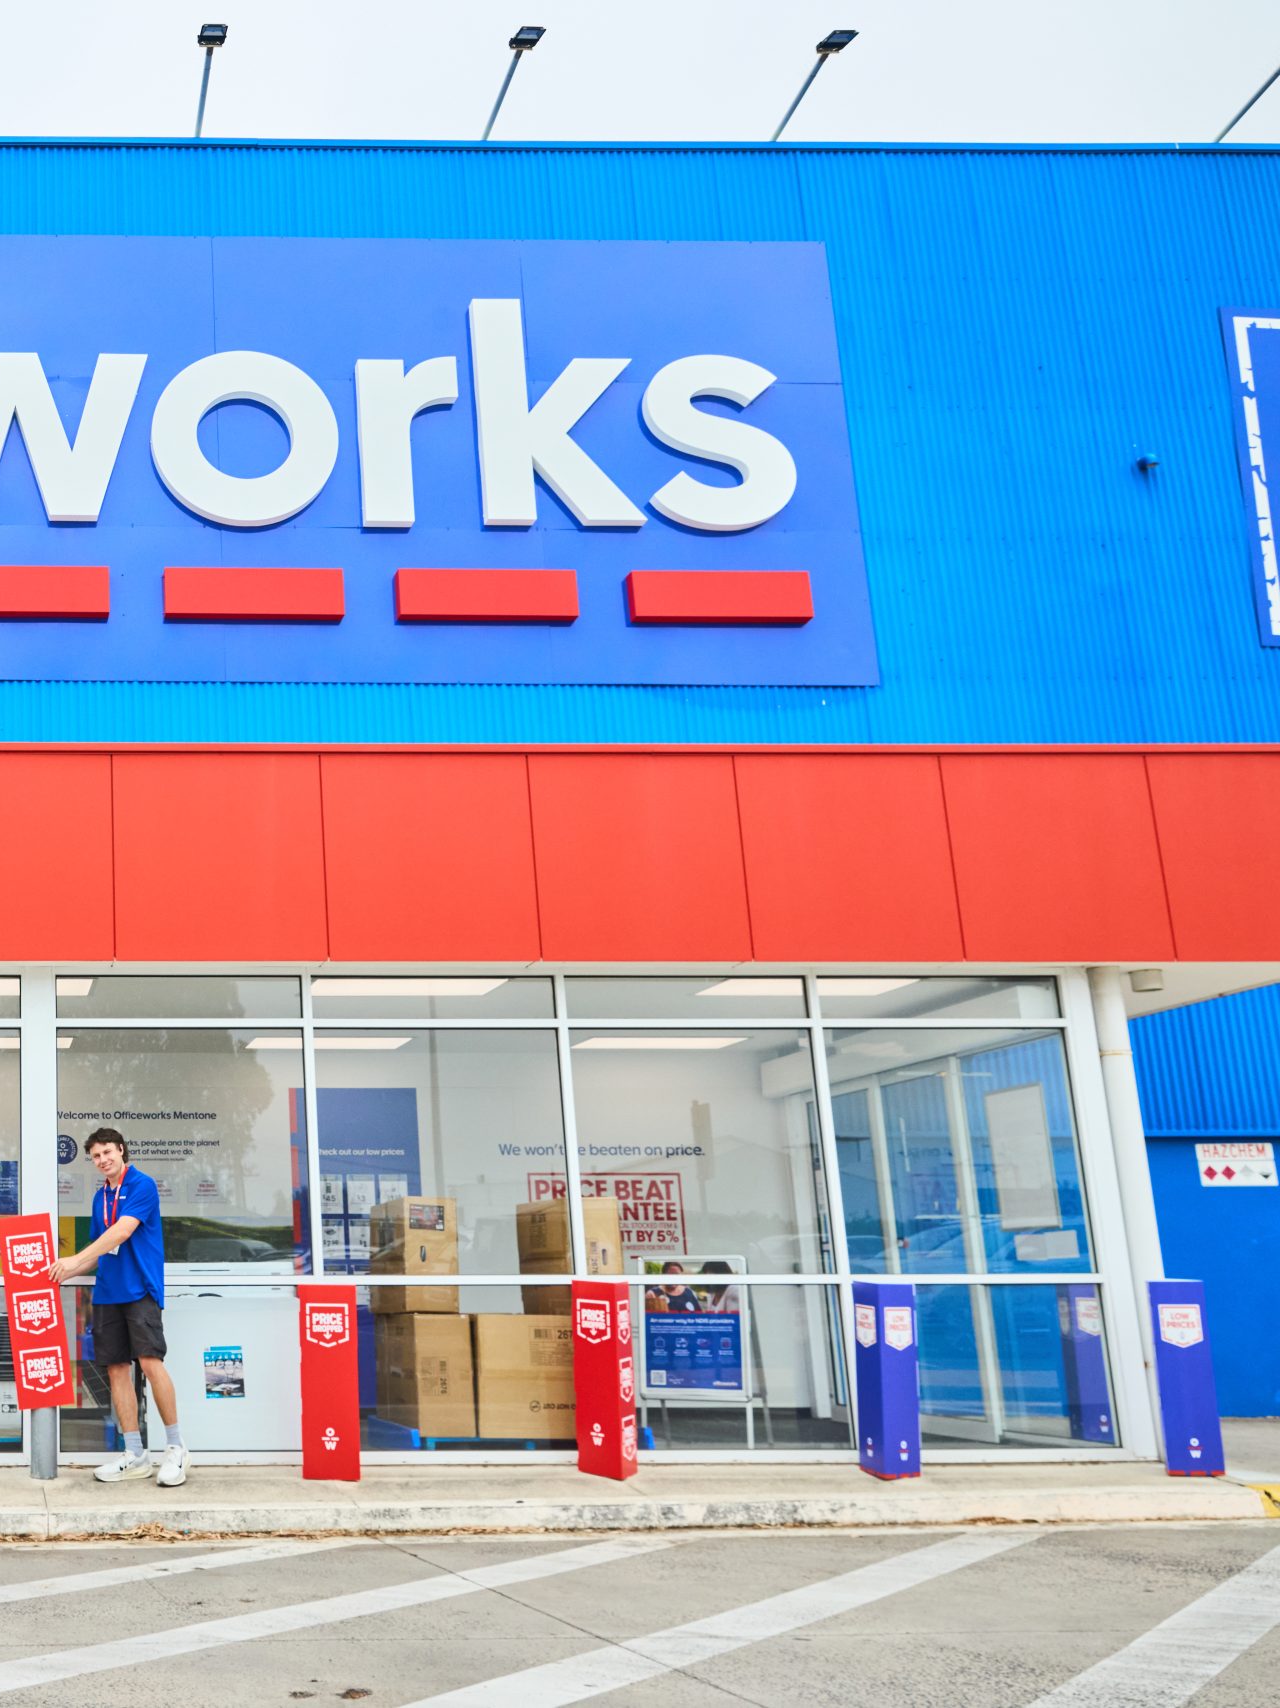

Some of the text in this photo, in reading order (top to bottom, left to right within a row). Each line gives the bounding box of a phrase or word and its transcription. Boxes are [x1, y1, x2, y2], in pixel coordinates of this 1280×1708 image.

[58, 1111, 217, 1120] Welcome to Officeworks Mentone
[141, 1140, 166, 1148] people
[167, 1139, 182, 1147] and
[183, 1139, 195, 1147] the
[196, 1139, 220, 1148] planet
[319, 1148, 337, 1156] heck
[366, 1148, 380, 1156] low
[381, 1148, 405, 1157] prices
[498, 1143, 521, 1156] We
[524, 1143, 564, 1156] won't
[589, 1143, 640, 1156] beaten
[644, 1146, 663, 1156] on
[666, 1143, 706, 1159] price.
[1202, 1143, 1266, 1158] HAZCHEM
[534, 1179, 674, 1201] PRCE BEAT
[636, 1230, 654, 1243] BY
[657, 1230, 679, 1243] 5%
[12, 1242, 42, 1256] PRICE
[14, 1254, 43, 1265] DROPPED
[19, 1299, 50, 1313] PRICE
[21, 1311, 51, 1322] DROPPED
[312, 1312, 343, 1325] PRICE
[580, 1308, 606, 1322] PRICE
[1170, 1312, 1189, 1320] LOW
[312, 1325, 343, 1333] DROPPED
[1166, 1321, 1196, 1329] PRICES
[557, 1329, 573, 1340] 267
[26, 1356, 57, 1370] PRICE
[28, 1368, 58, 1380] DROPPED
